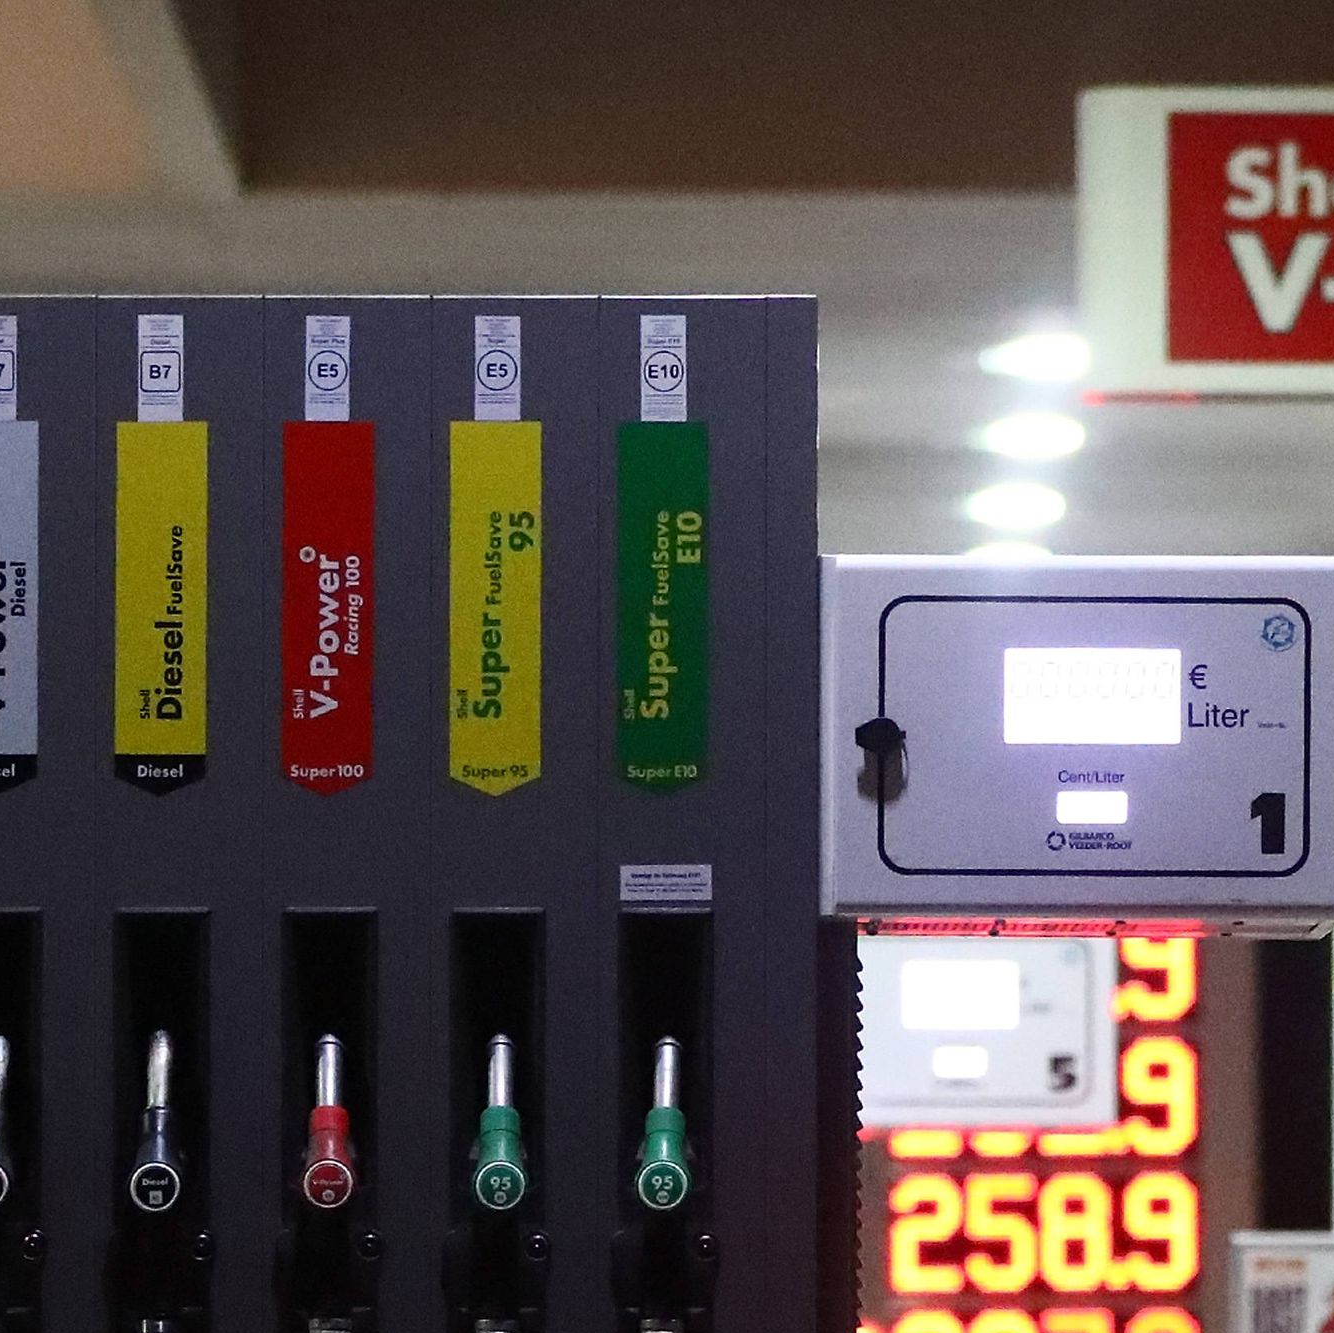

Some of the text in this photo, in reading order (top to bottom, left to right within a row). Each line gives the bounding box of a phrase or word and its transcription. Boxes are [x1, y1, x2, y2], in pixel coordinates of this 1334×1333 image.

[149, 365, 172, 379] B7
[317, 363, 339, 378] E5
[487, 363, 508, 378] E5
[648, 364, 679, 379] E10
[508, 511, 535, 552] 95
[676, 511, 703, 564] E10
[10, 562, 27, 617] Diesel
[344, 555, 364, 655] Racing 100
[473, 511, 511, 719] Super FuelSave
[640, 510, 678, 719] Super FuelSave
[154, 525, 183, 720] Diesel FuelSave
[310, 554, 340, 719] V-Power
[1188, 664, 1208, 690] €
[139, 689, 151, 719] Shell
[292, 689, 304, 719] Shell
[457, 689, 469, 719] Shell
[1188, 702, 1250, 728] Liter
[137, 764, 184, 778] Diesel
[674, 765, 698, 778] E10
[1058, 770, 1125, 784] Cent/Liter
[1251, 793, 1286, 855] 1
[1049, 1055, 1077, 1091] 5
[490, 1176, 512, 1190] 95
[651, 1175, 674, 1190] 95
